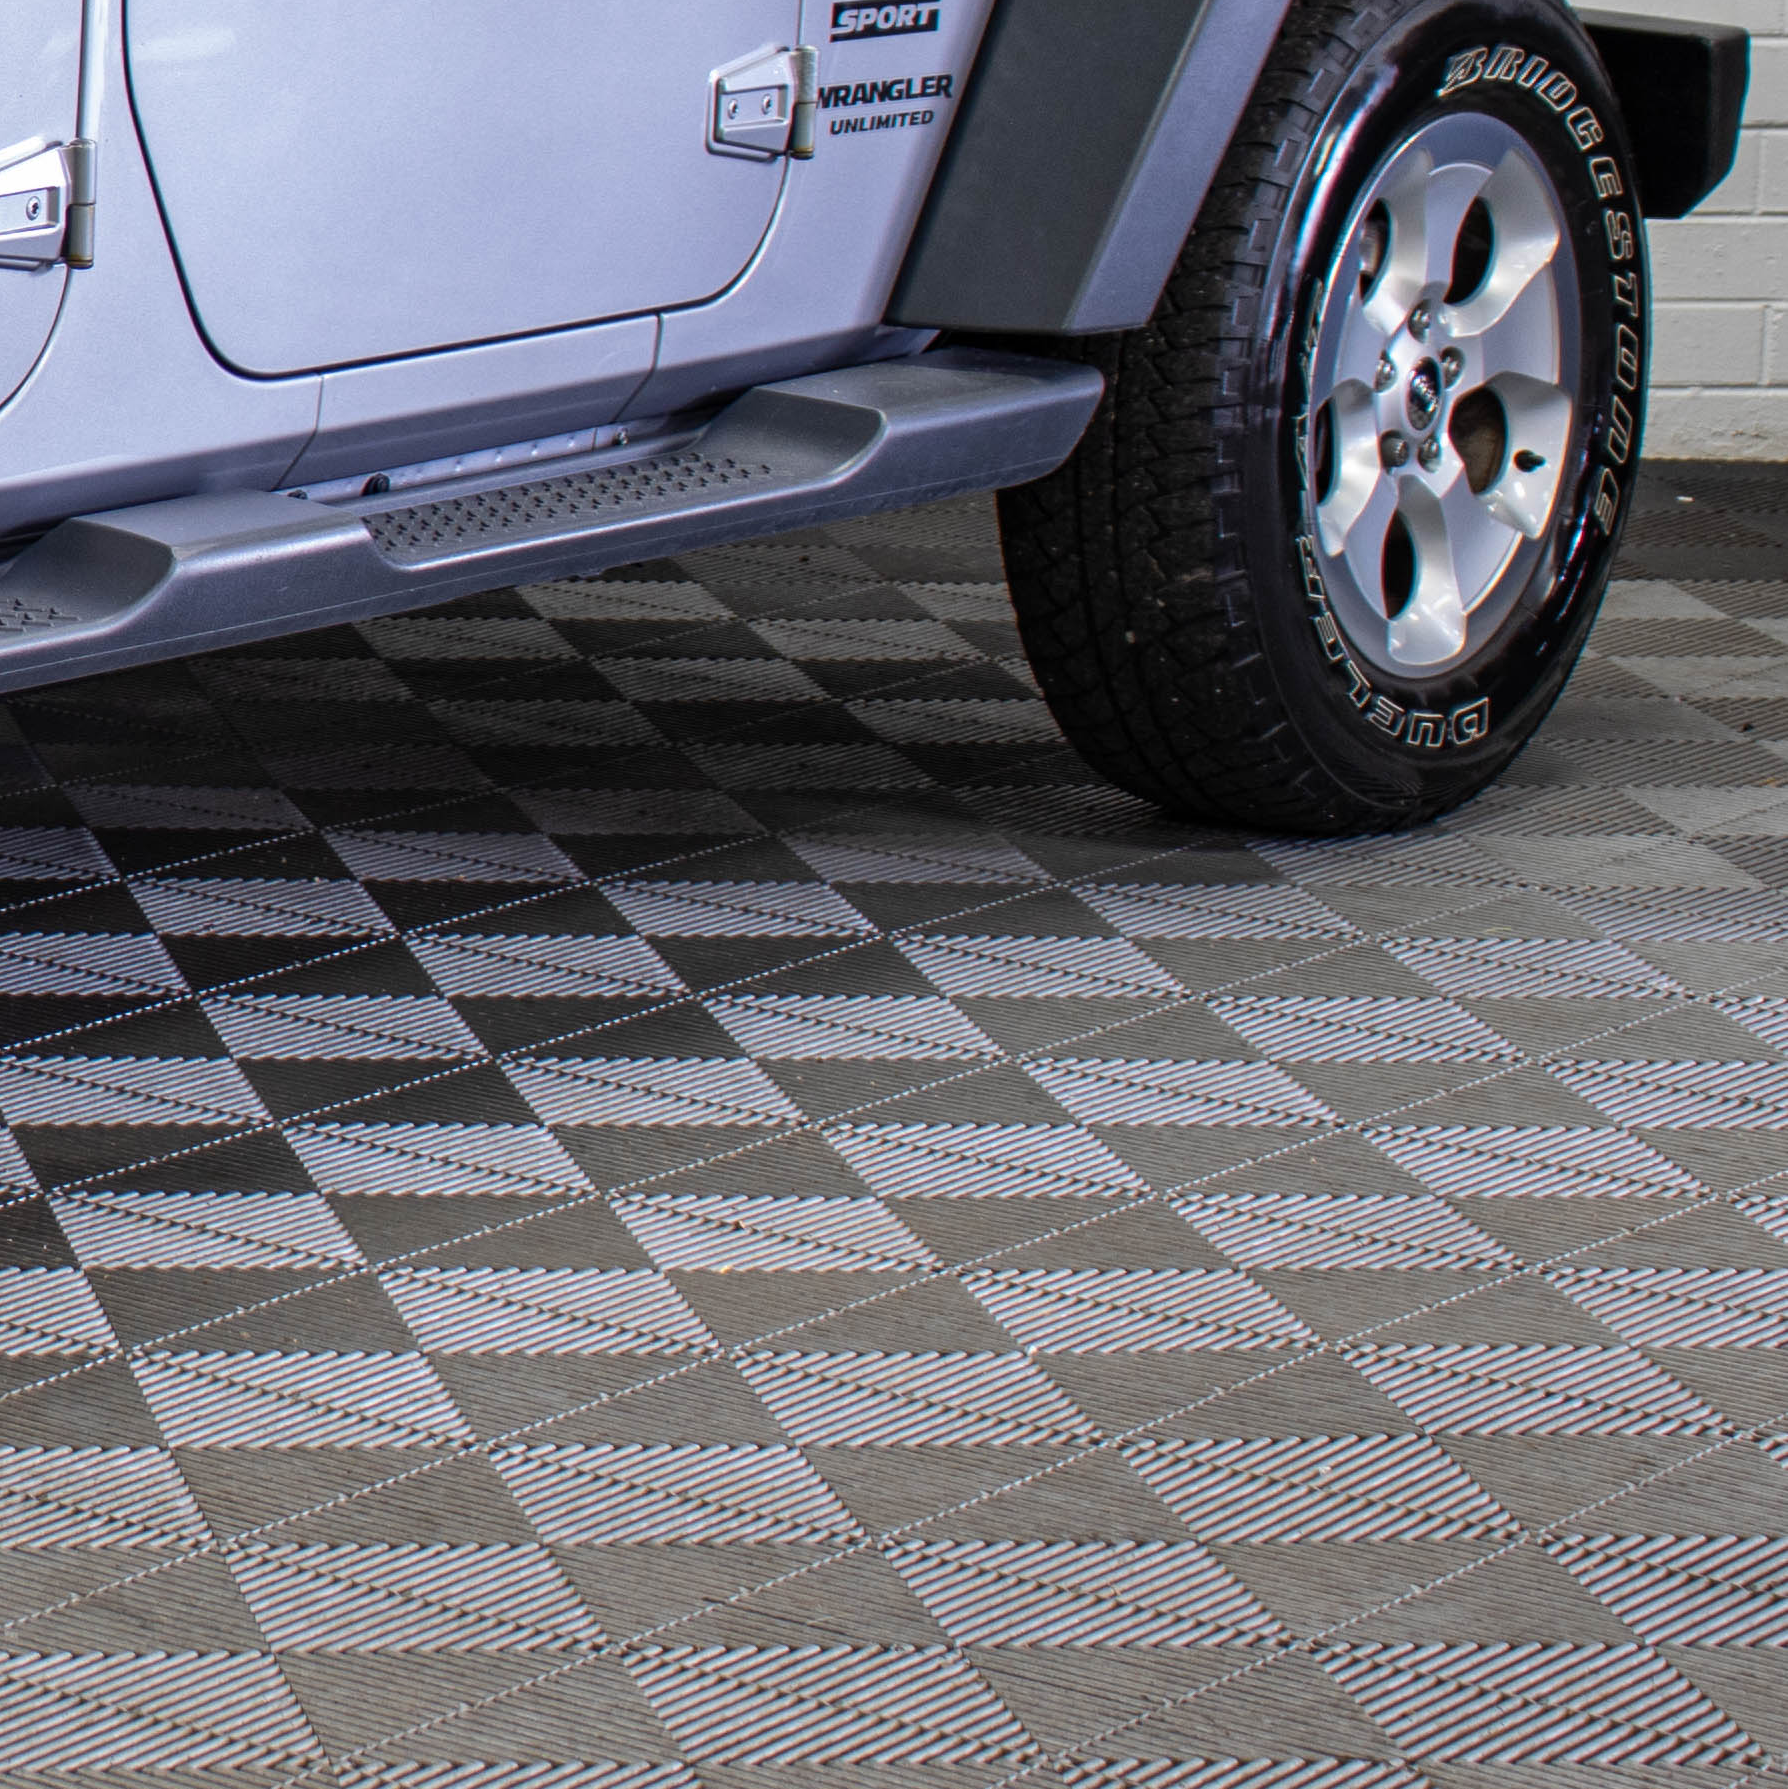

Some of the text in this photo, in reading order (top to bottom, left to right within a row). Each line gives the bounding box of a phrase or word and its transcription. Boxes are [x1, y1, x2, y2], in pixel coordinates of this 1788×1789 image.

[816, 74, 952, 109] WRANGLER
[829, 110, 934, 135] UNLIMITED
[1439, 45, 1636, 535] BRIDGESTONE
[1296, 533, 1490, 748] DUELER
